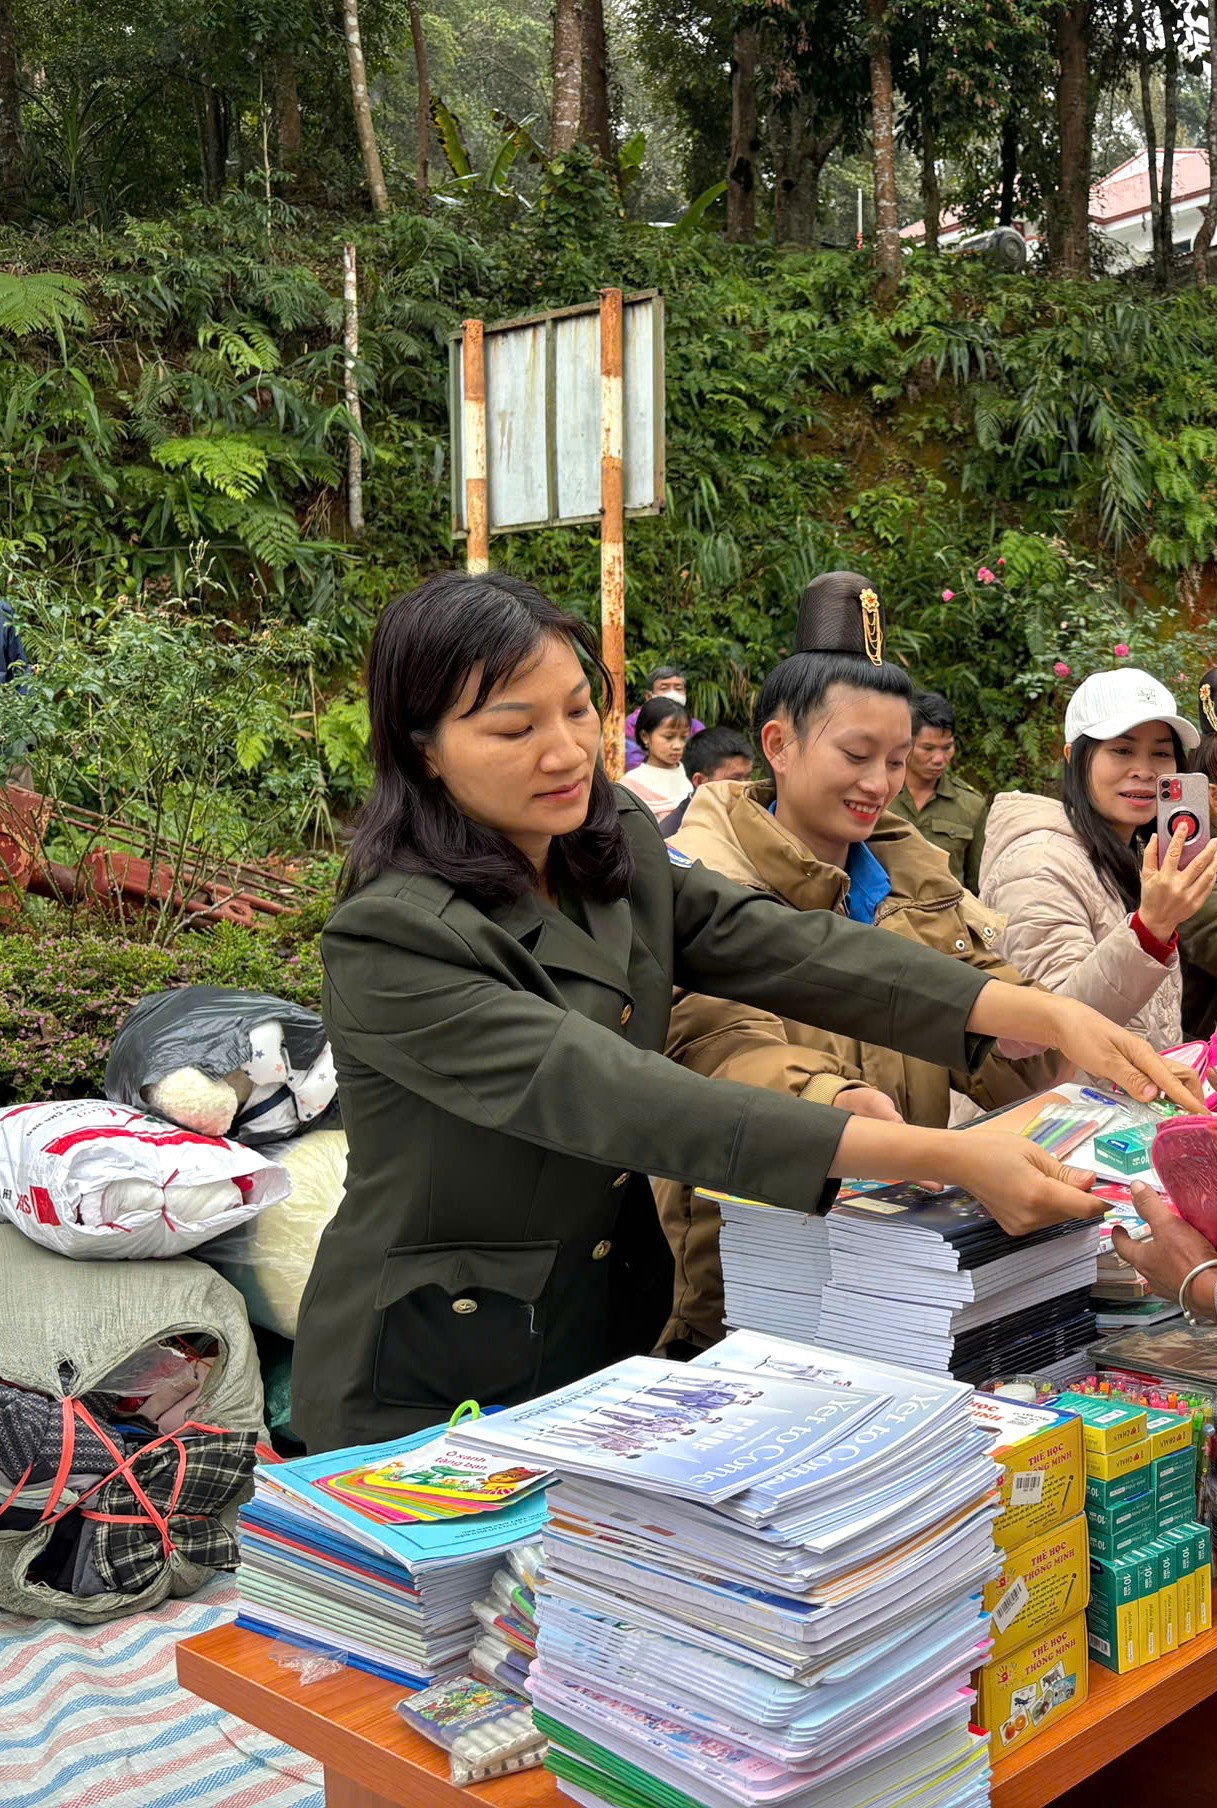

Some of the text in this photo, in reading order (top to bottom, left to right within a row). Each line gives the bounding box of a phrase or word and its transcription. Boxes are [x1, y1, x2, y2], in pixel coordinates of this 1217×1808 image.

[804, 1399, 861, 1425] Yet
[885, 1394, 943, 1424] Yet
[775, 1425, 812, 1444] to
[854, 1424, 891, 1444] to
[689, 1444, 785, 1484] Come
[1054, 1547, 1075, 1566] MINH
[1055, 1638, 1077, 1658] MINH
